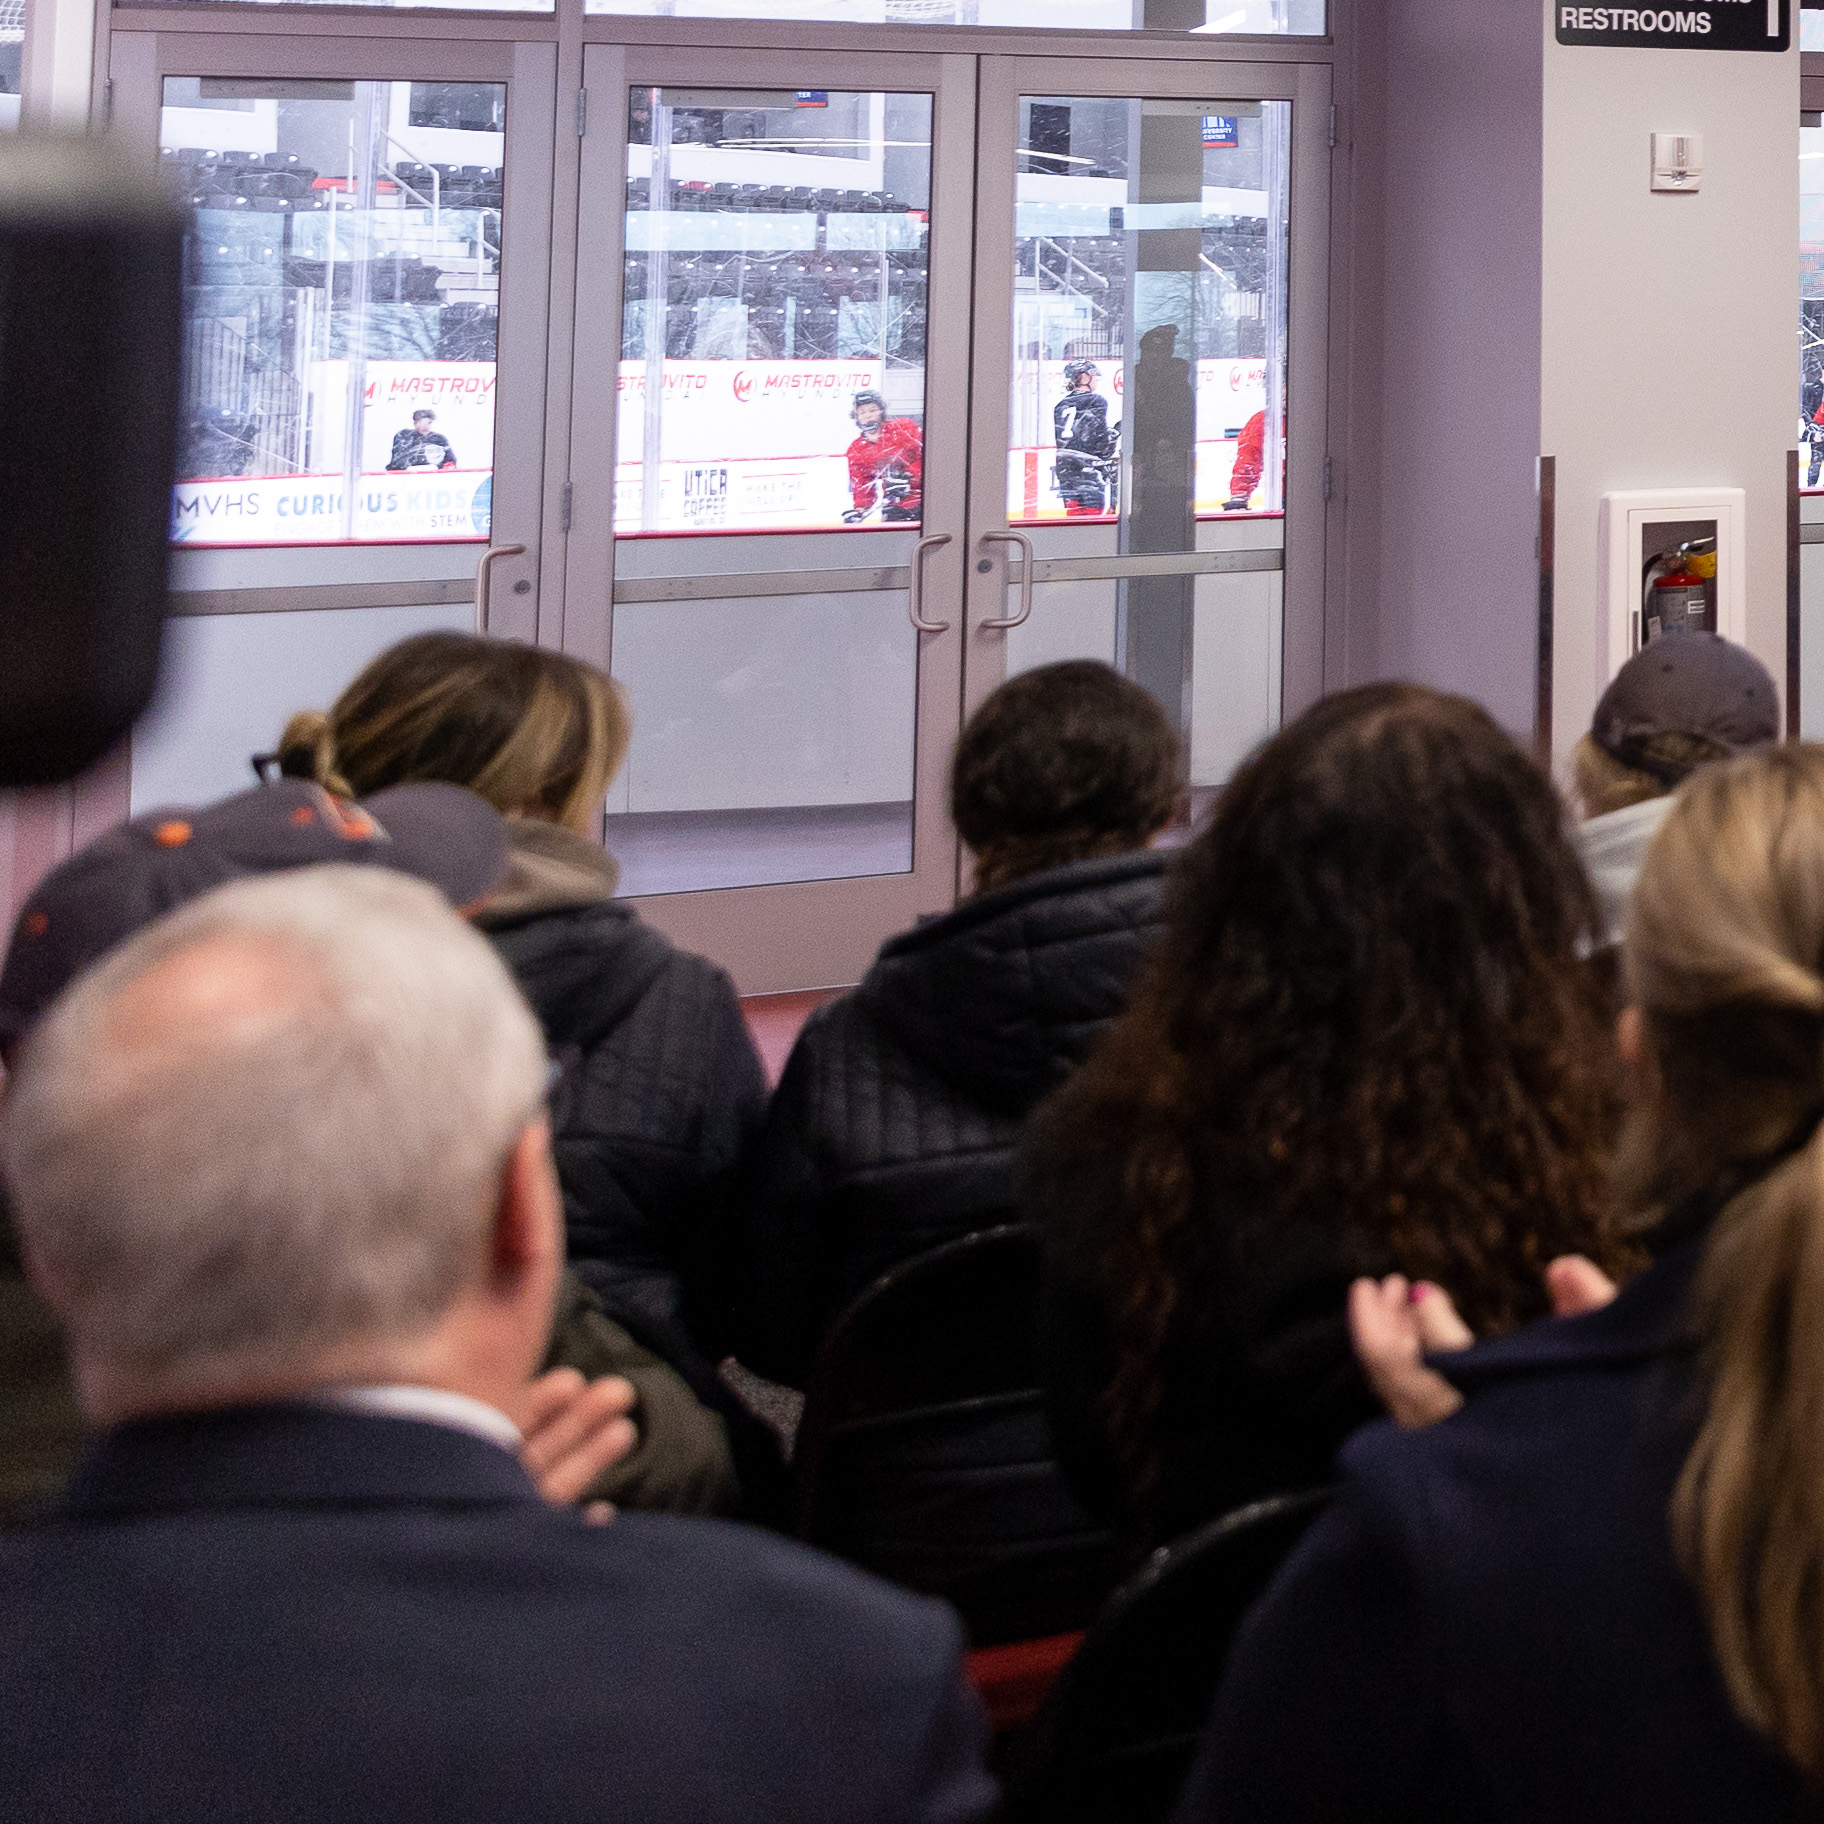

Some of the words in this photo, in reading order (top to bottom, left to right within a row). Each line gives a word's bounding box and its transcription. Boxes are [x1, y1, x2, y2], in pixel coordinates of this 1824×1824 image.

[1560, 6, 1712, 34] RESTROOMS
[764, 373, 872, 388] MASTROVITO
[1061, 406, 1077, 438] 7
[177, 493, 260, 519] MVHS
[406, 488, 468, 510] KIDS
[429, 513, 468, 528] STEM
